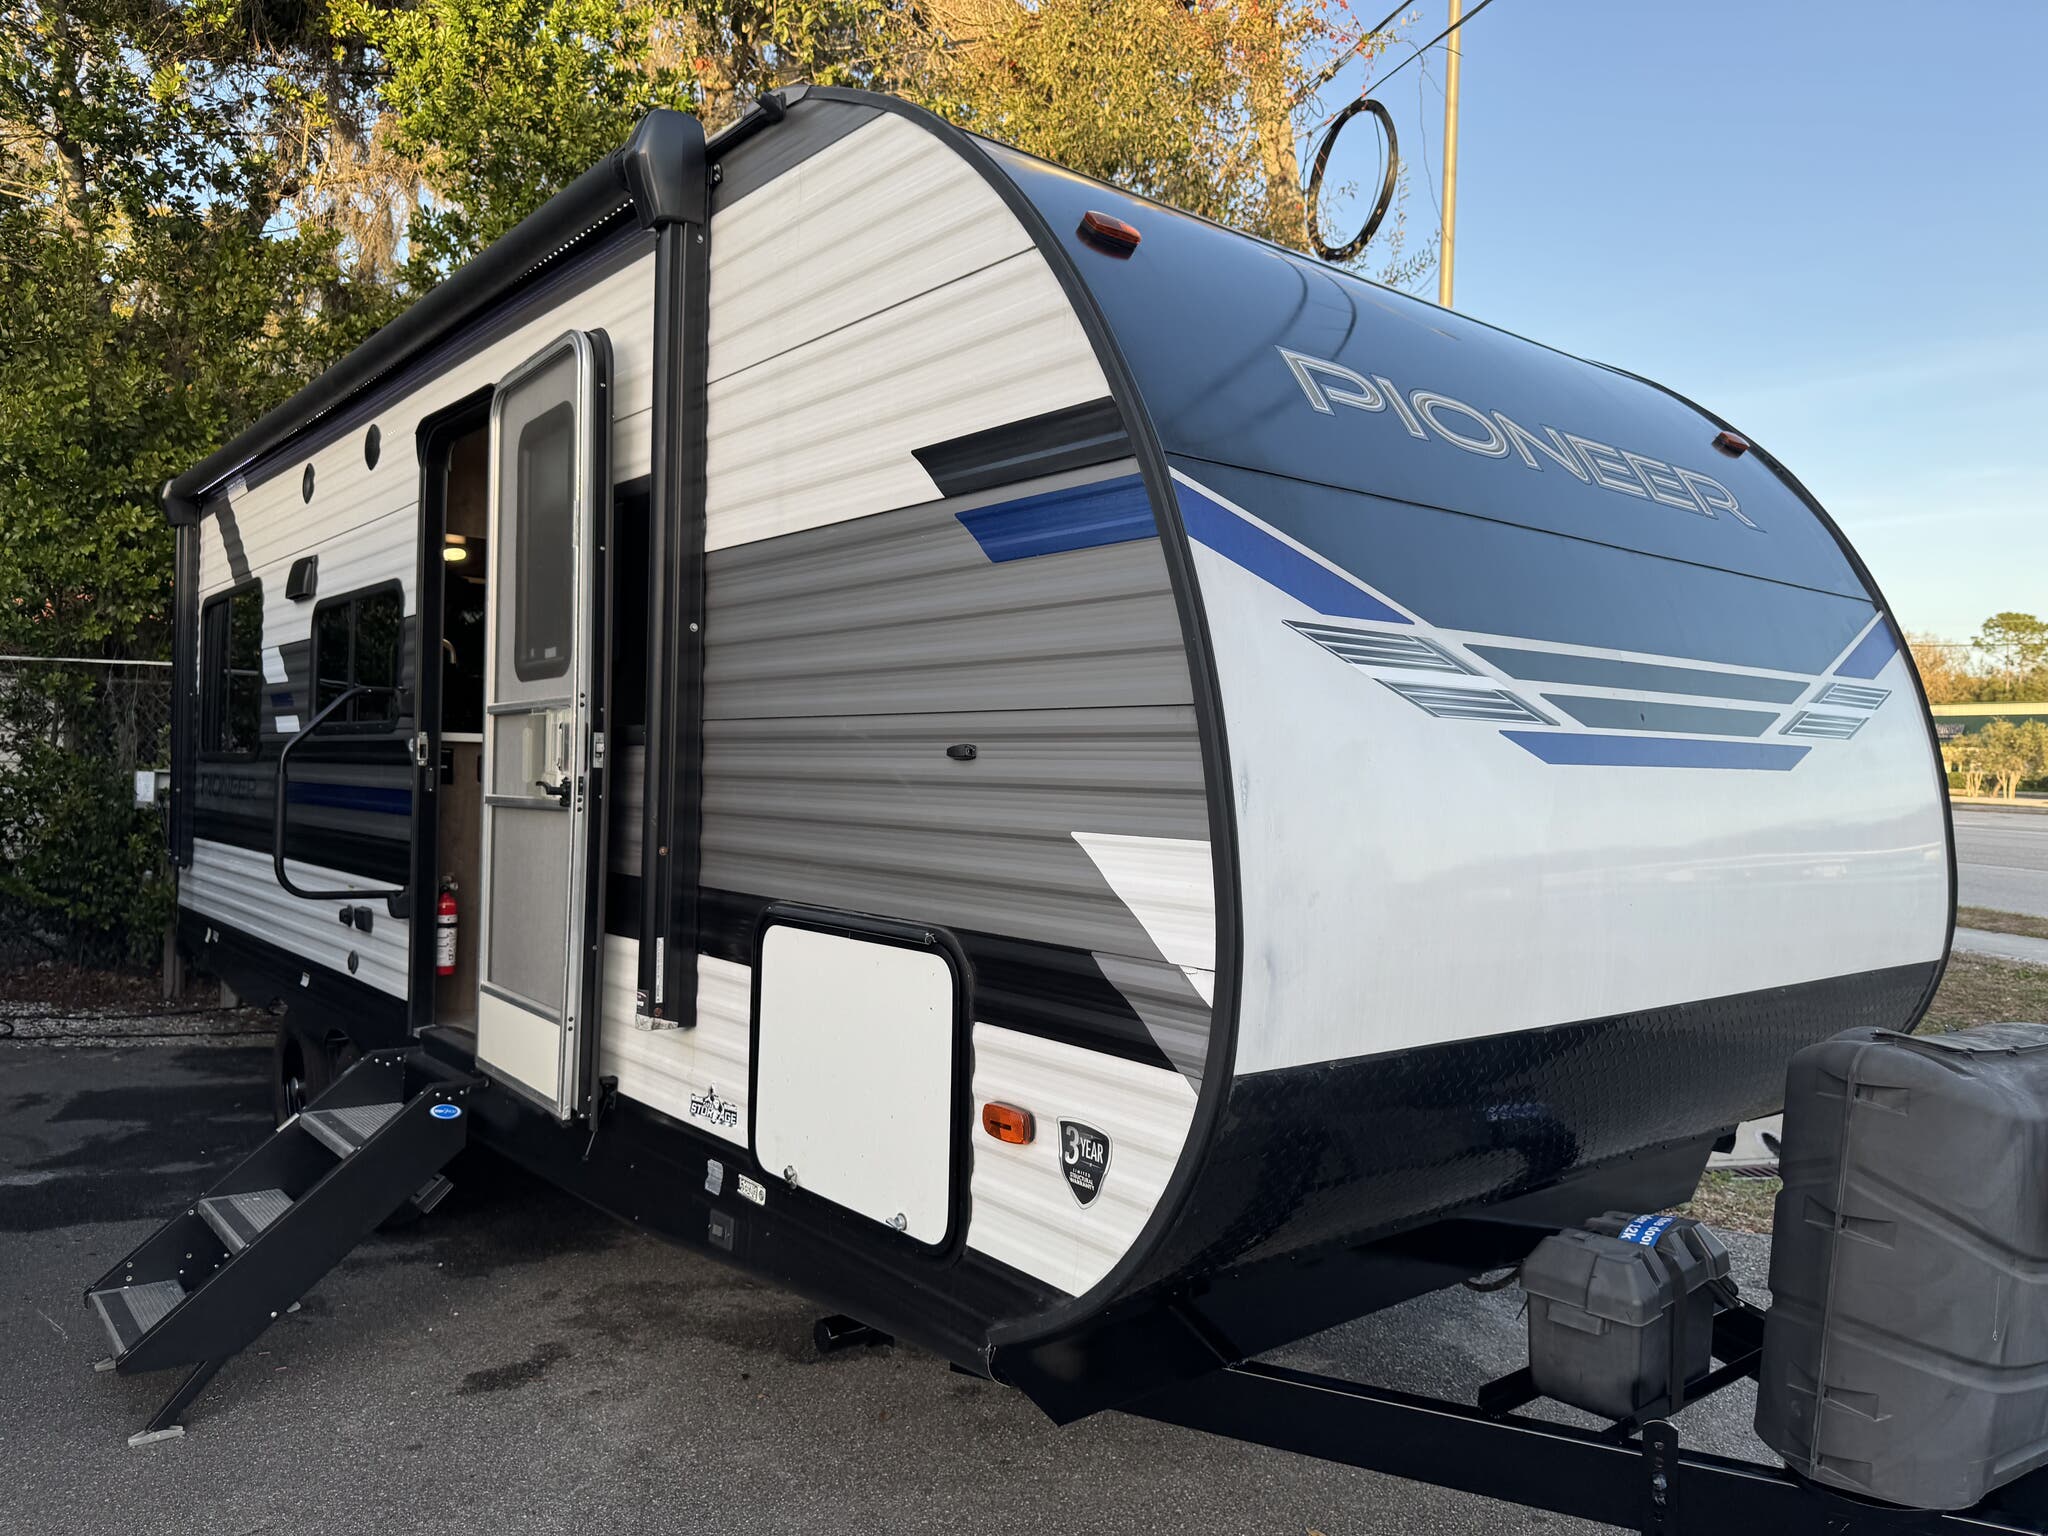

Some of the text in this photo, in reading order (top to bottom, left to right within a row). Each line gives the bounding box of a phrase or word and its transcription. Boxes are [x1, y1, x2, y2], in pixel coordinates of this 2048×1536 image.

[1274, 345, 1767, 533] PIONEER
[690, 1102, 738, 1125] STORAGE
[1064, 1125, 1104, 1165] 3 YEAR
[1620, 1224, 1642, 1240] 12k
